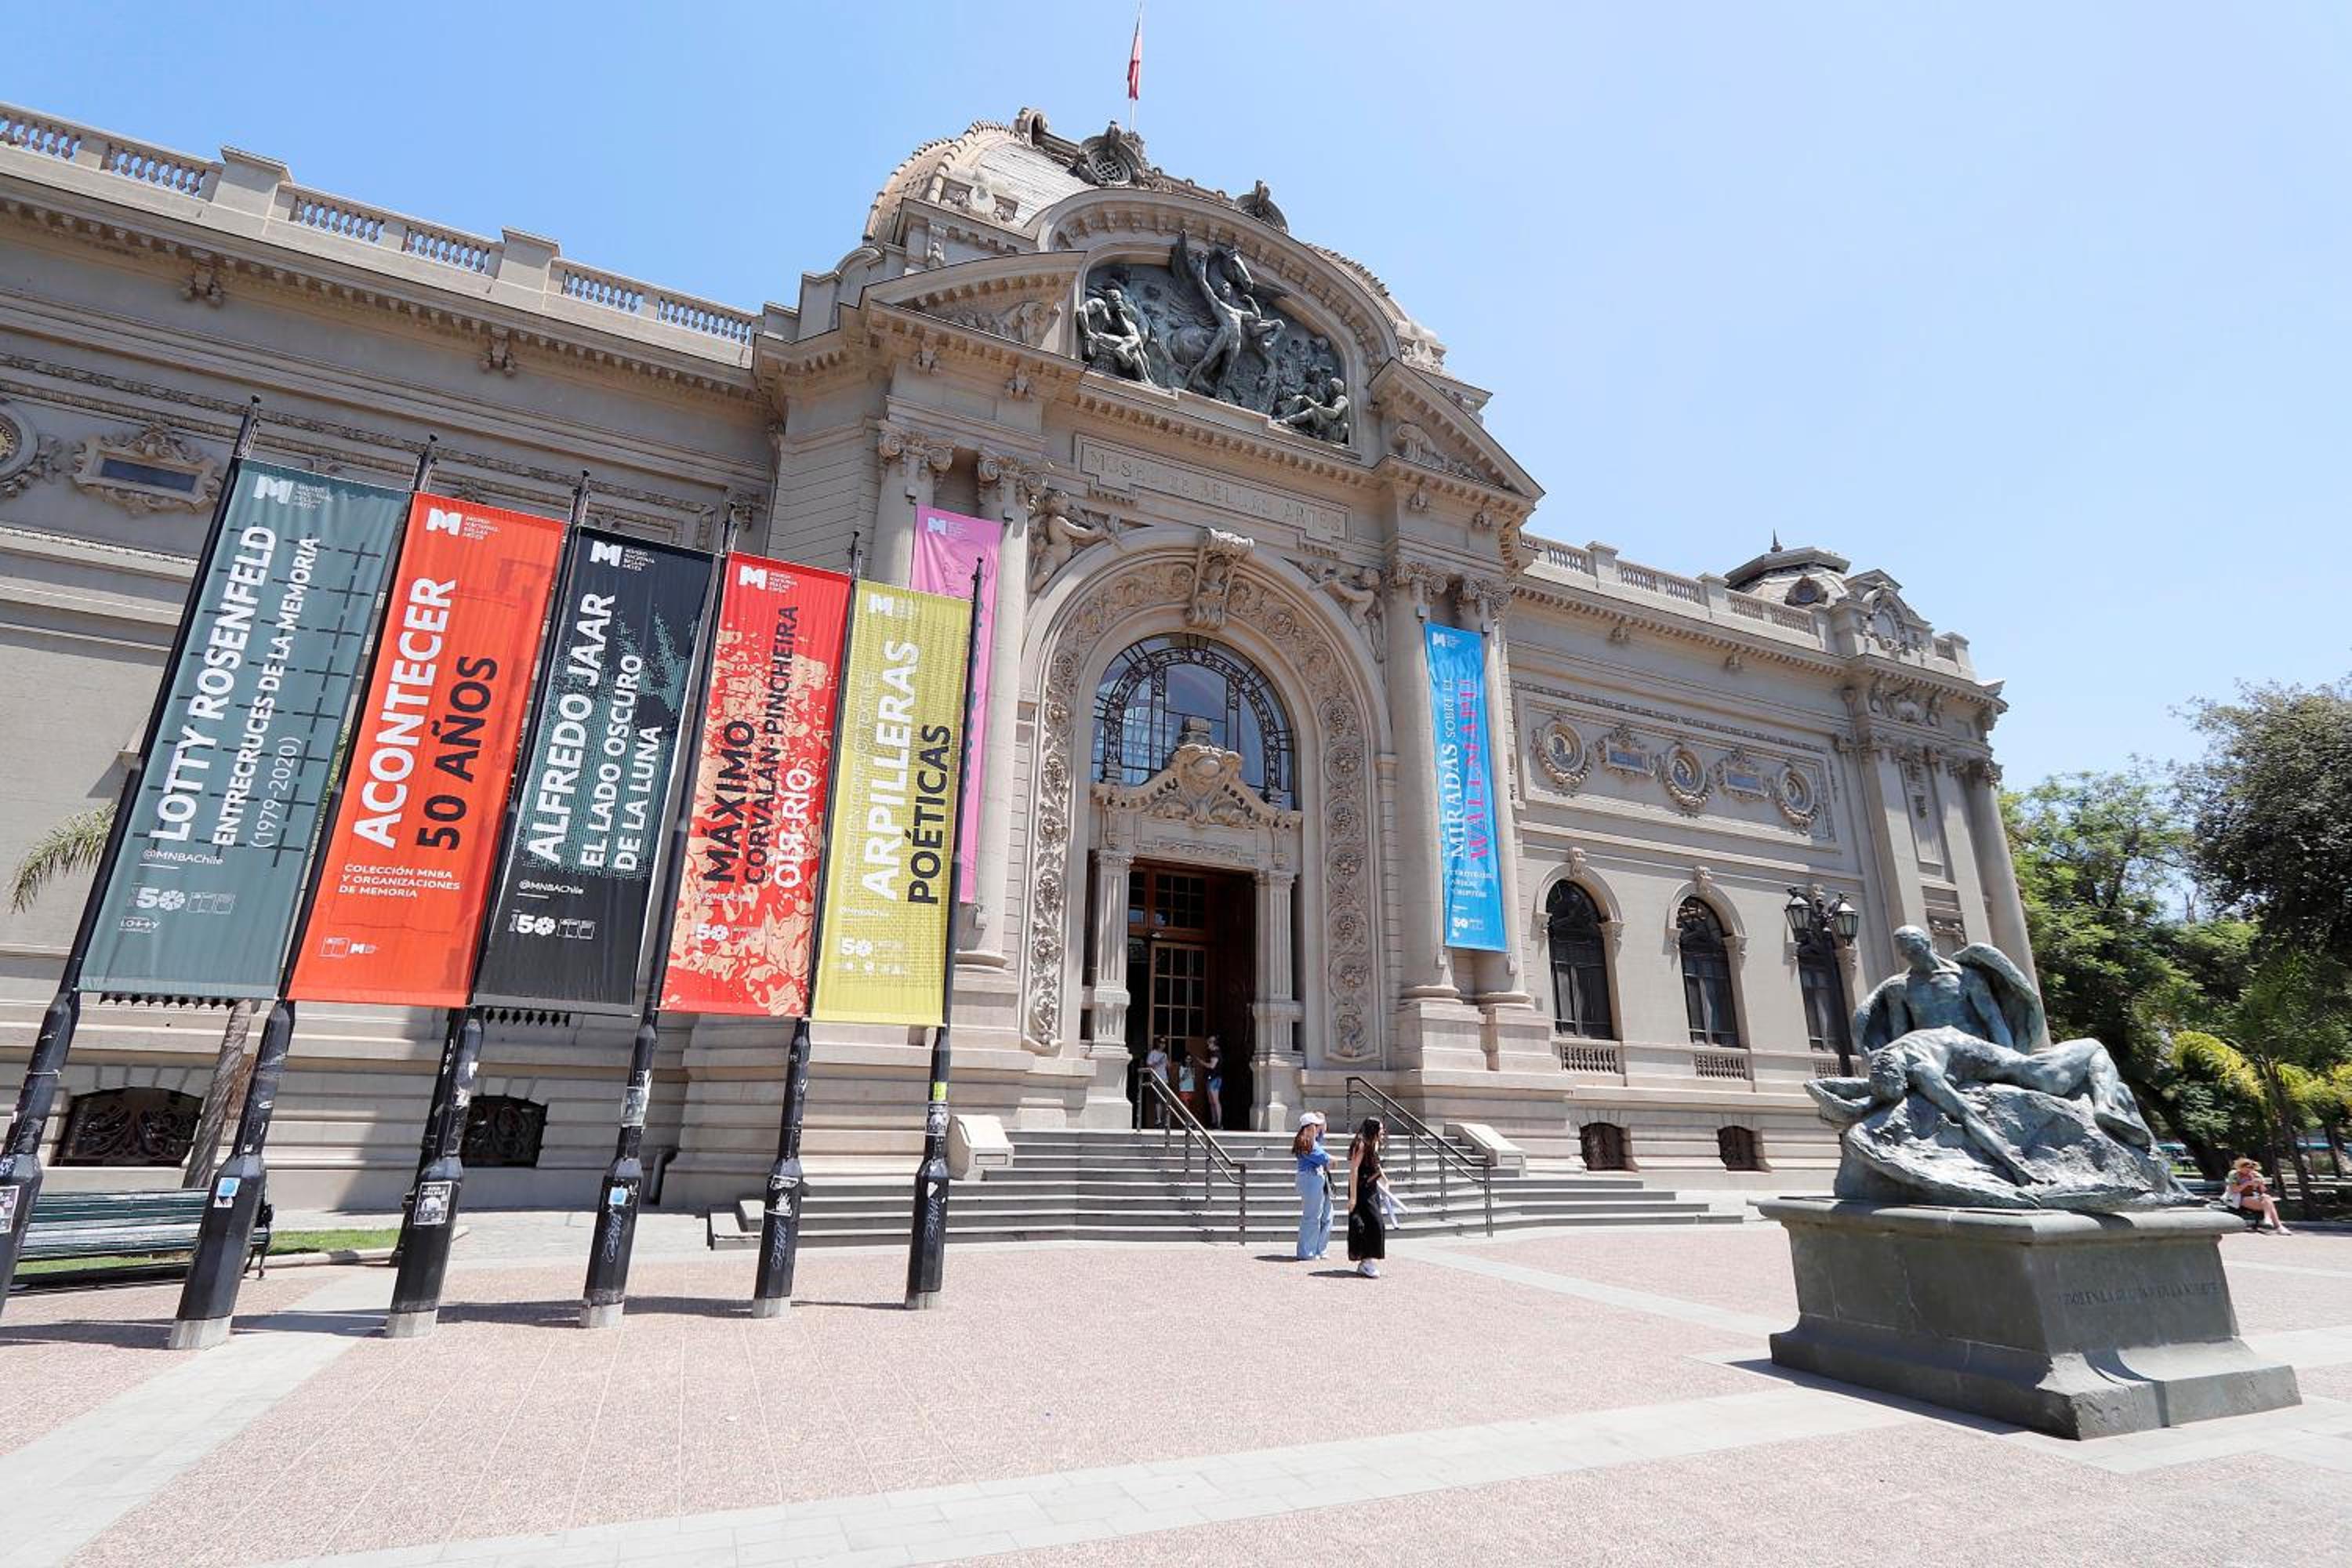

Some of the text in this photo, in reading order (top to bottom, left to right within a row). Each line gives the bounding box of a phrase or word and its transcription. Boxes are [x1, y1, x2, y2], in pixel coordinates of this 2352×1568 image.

[267, 635, 295, 661] LA
[276, 537, 321, 632] MEMORIA
[150, 725, 217, 841] LOTTY
[187, 525, 276, 720] ROSENFELD
[258, 663, 285, 692] DE
[353, 577, 458, 849] ACONTECER
[416, 655, 499, 851] 50 AÑOS
[526, 693, 593, 865] ALFREDO
[566, 593, 615, 687] JAAR
[744, 605, 799, 886] CORVALÁN-PINCHEIRA
[212, 690, 275, 847] ENTRECRUCES
[250, 735, 302, 849] (1979-2020)
[580, 655, 643, 868] EL LADO OSCURO
[613, 725, 663, 872] DE LA LUNA
[701, 720, 756, 884] MÁXIMO
[861, 639, 920, 902] ARPILLERAS
[904, 724, 952, 905] POÉTICAS
[1441, 743, 1465, 859] MIRADAS
[1457, 677, 1488, 860] WALLMAPU
[143, 848, 224, 866] @MNBAChile
[338, 885, 419, 899] DE MEMORIA
[340, 874, 461, 891] Y ORGANIZACIONES
[343, 863, 453, 880] COLECCIÓN MNBA
